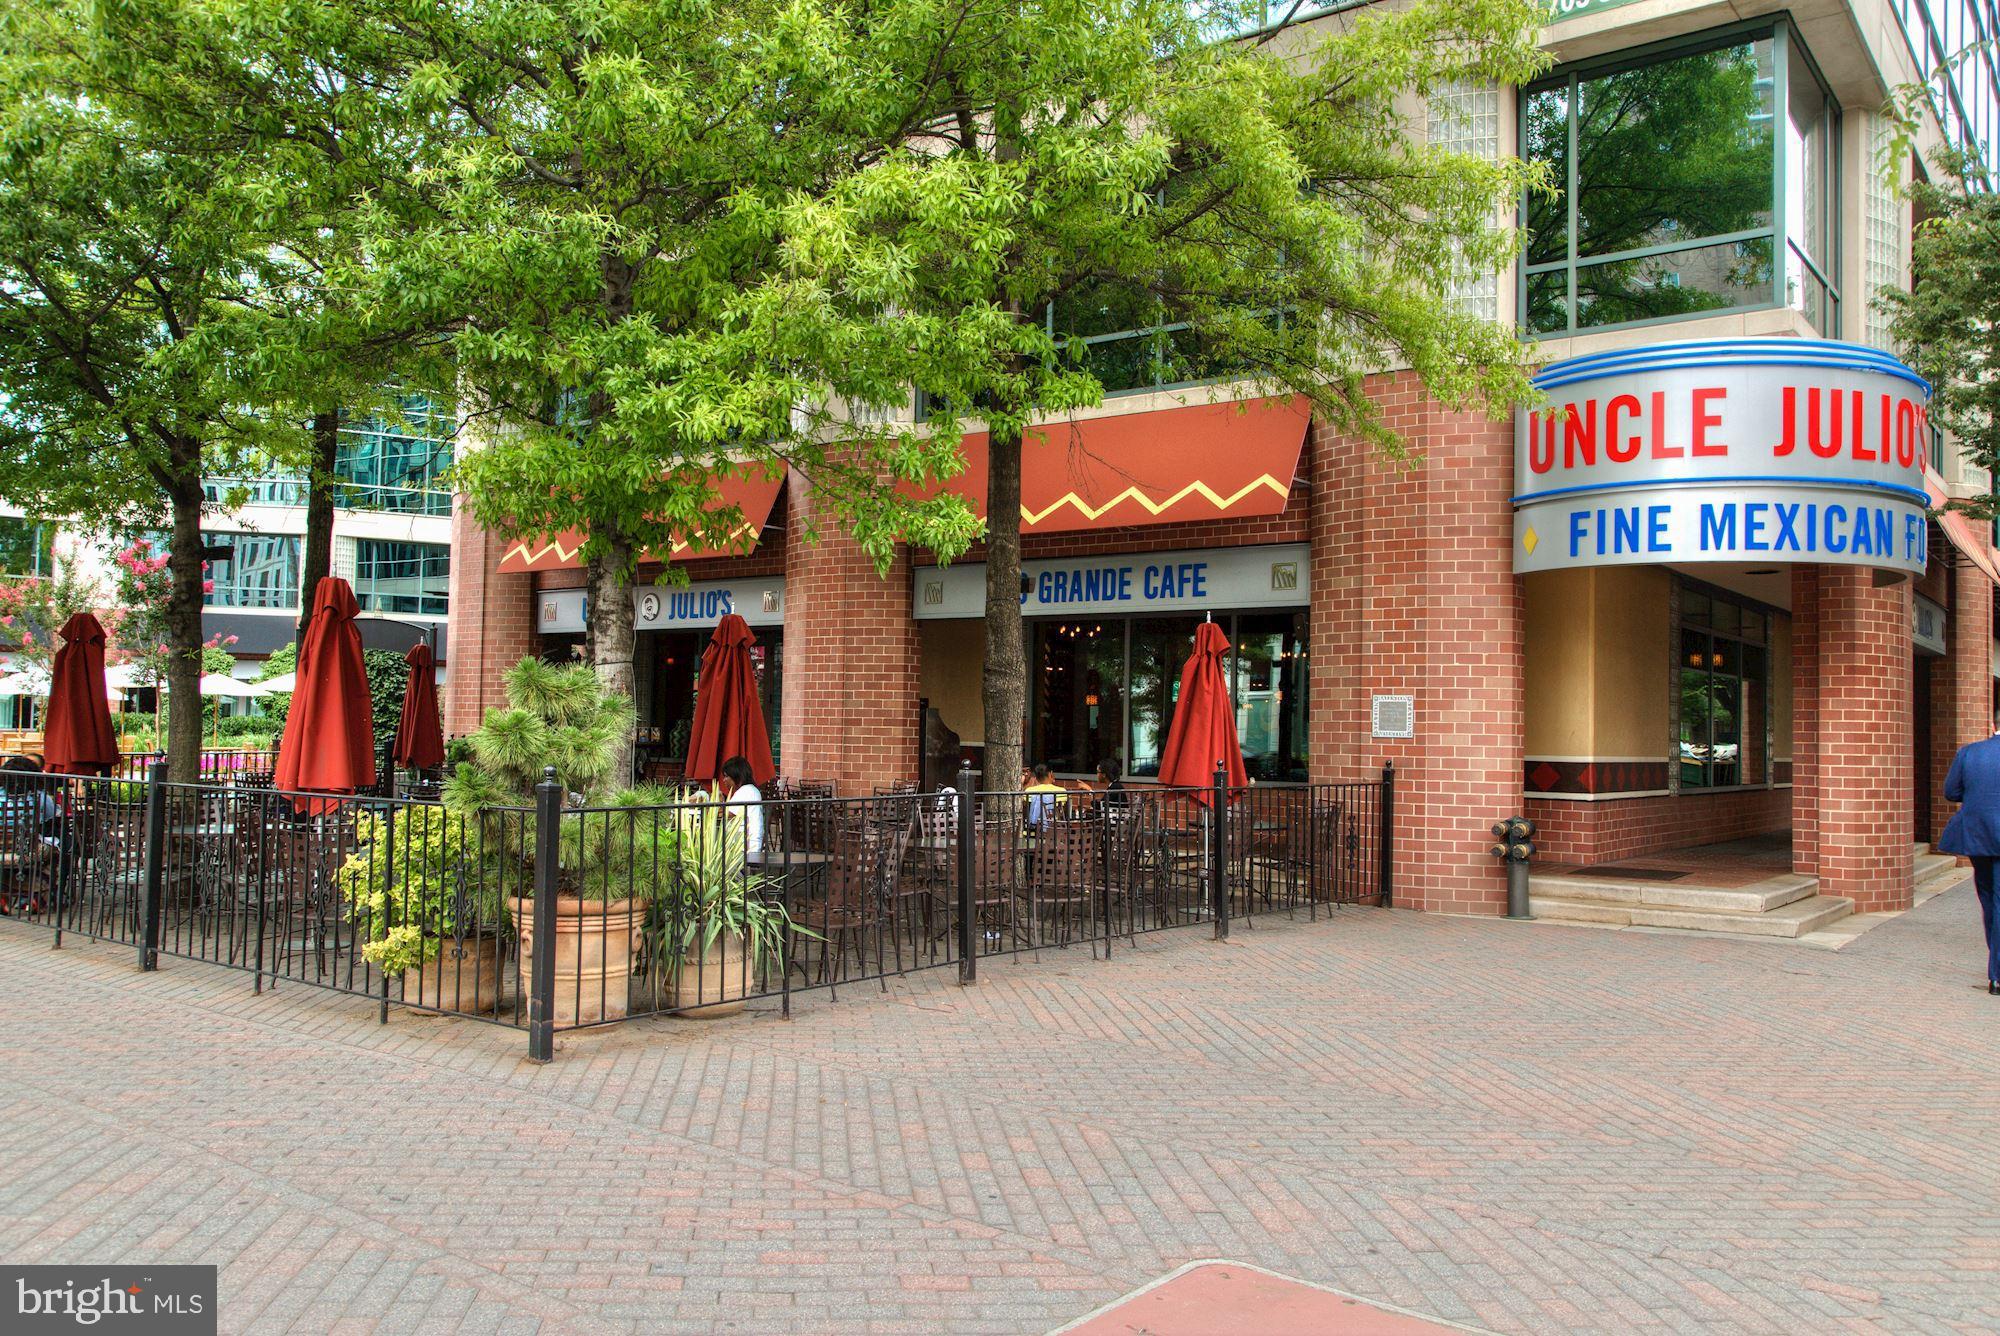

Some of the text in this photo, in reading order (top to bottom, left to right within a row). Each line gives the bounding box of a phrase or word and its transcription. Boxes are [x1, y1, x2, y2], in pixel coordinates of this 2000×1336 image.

[1529, 386, 1928, 475] UNCLE JULIO'S
[1570, 505, 1672, 557] FINE
[1700, 503, 1894, 558] MEXICAN
[668, 589, 732, 620] JULIO'S
[1039, 567, 1132, 604] GRANDE
[1144, 563, 1207, 600] CAFE
